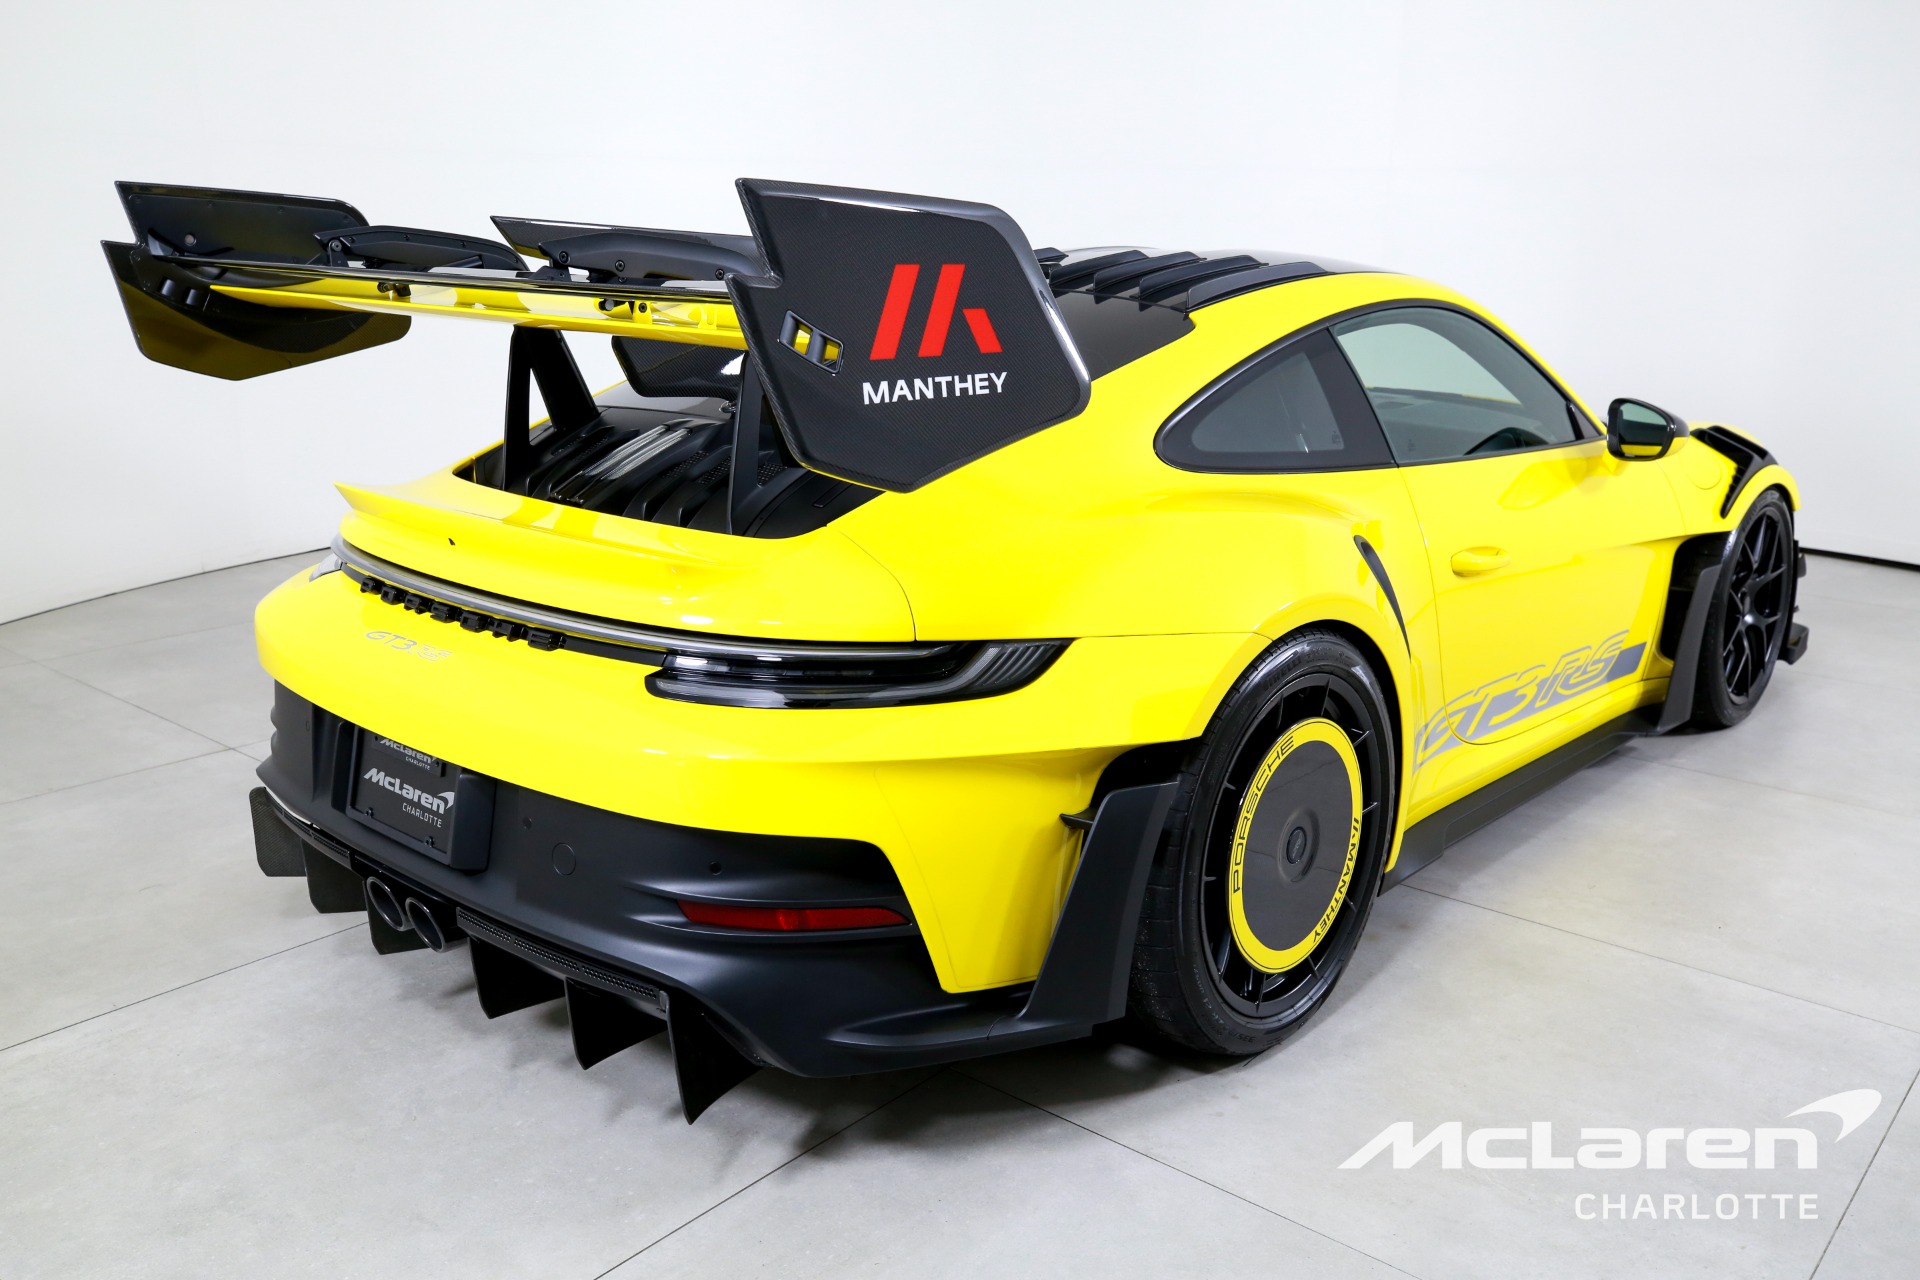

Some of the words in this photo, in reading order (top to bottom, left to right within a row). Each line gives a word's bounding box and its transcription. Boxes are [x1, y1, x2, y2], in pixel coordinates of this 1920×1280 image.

[862, 371, 1007, 405] MANTHEY
[366, 631, 417, 650] GT3
[380, 738, 432, 764] McLaren
[405, 756, 430, 771] CHARLOTTE
[363, 767, 444, 814] McLaren
[402, 802, 442, 828] CHARLOTTE
[1233, 736, 1294, 893] PORSCHE
[1313, 845, 1358, 943] MANTHEY
